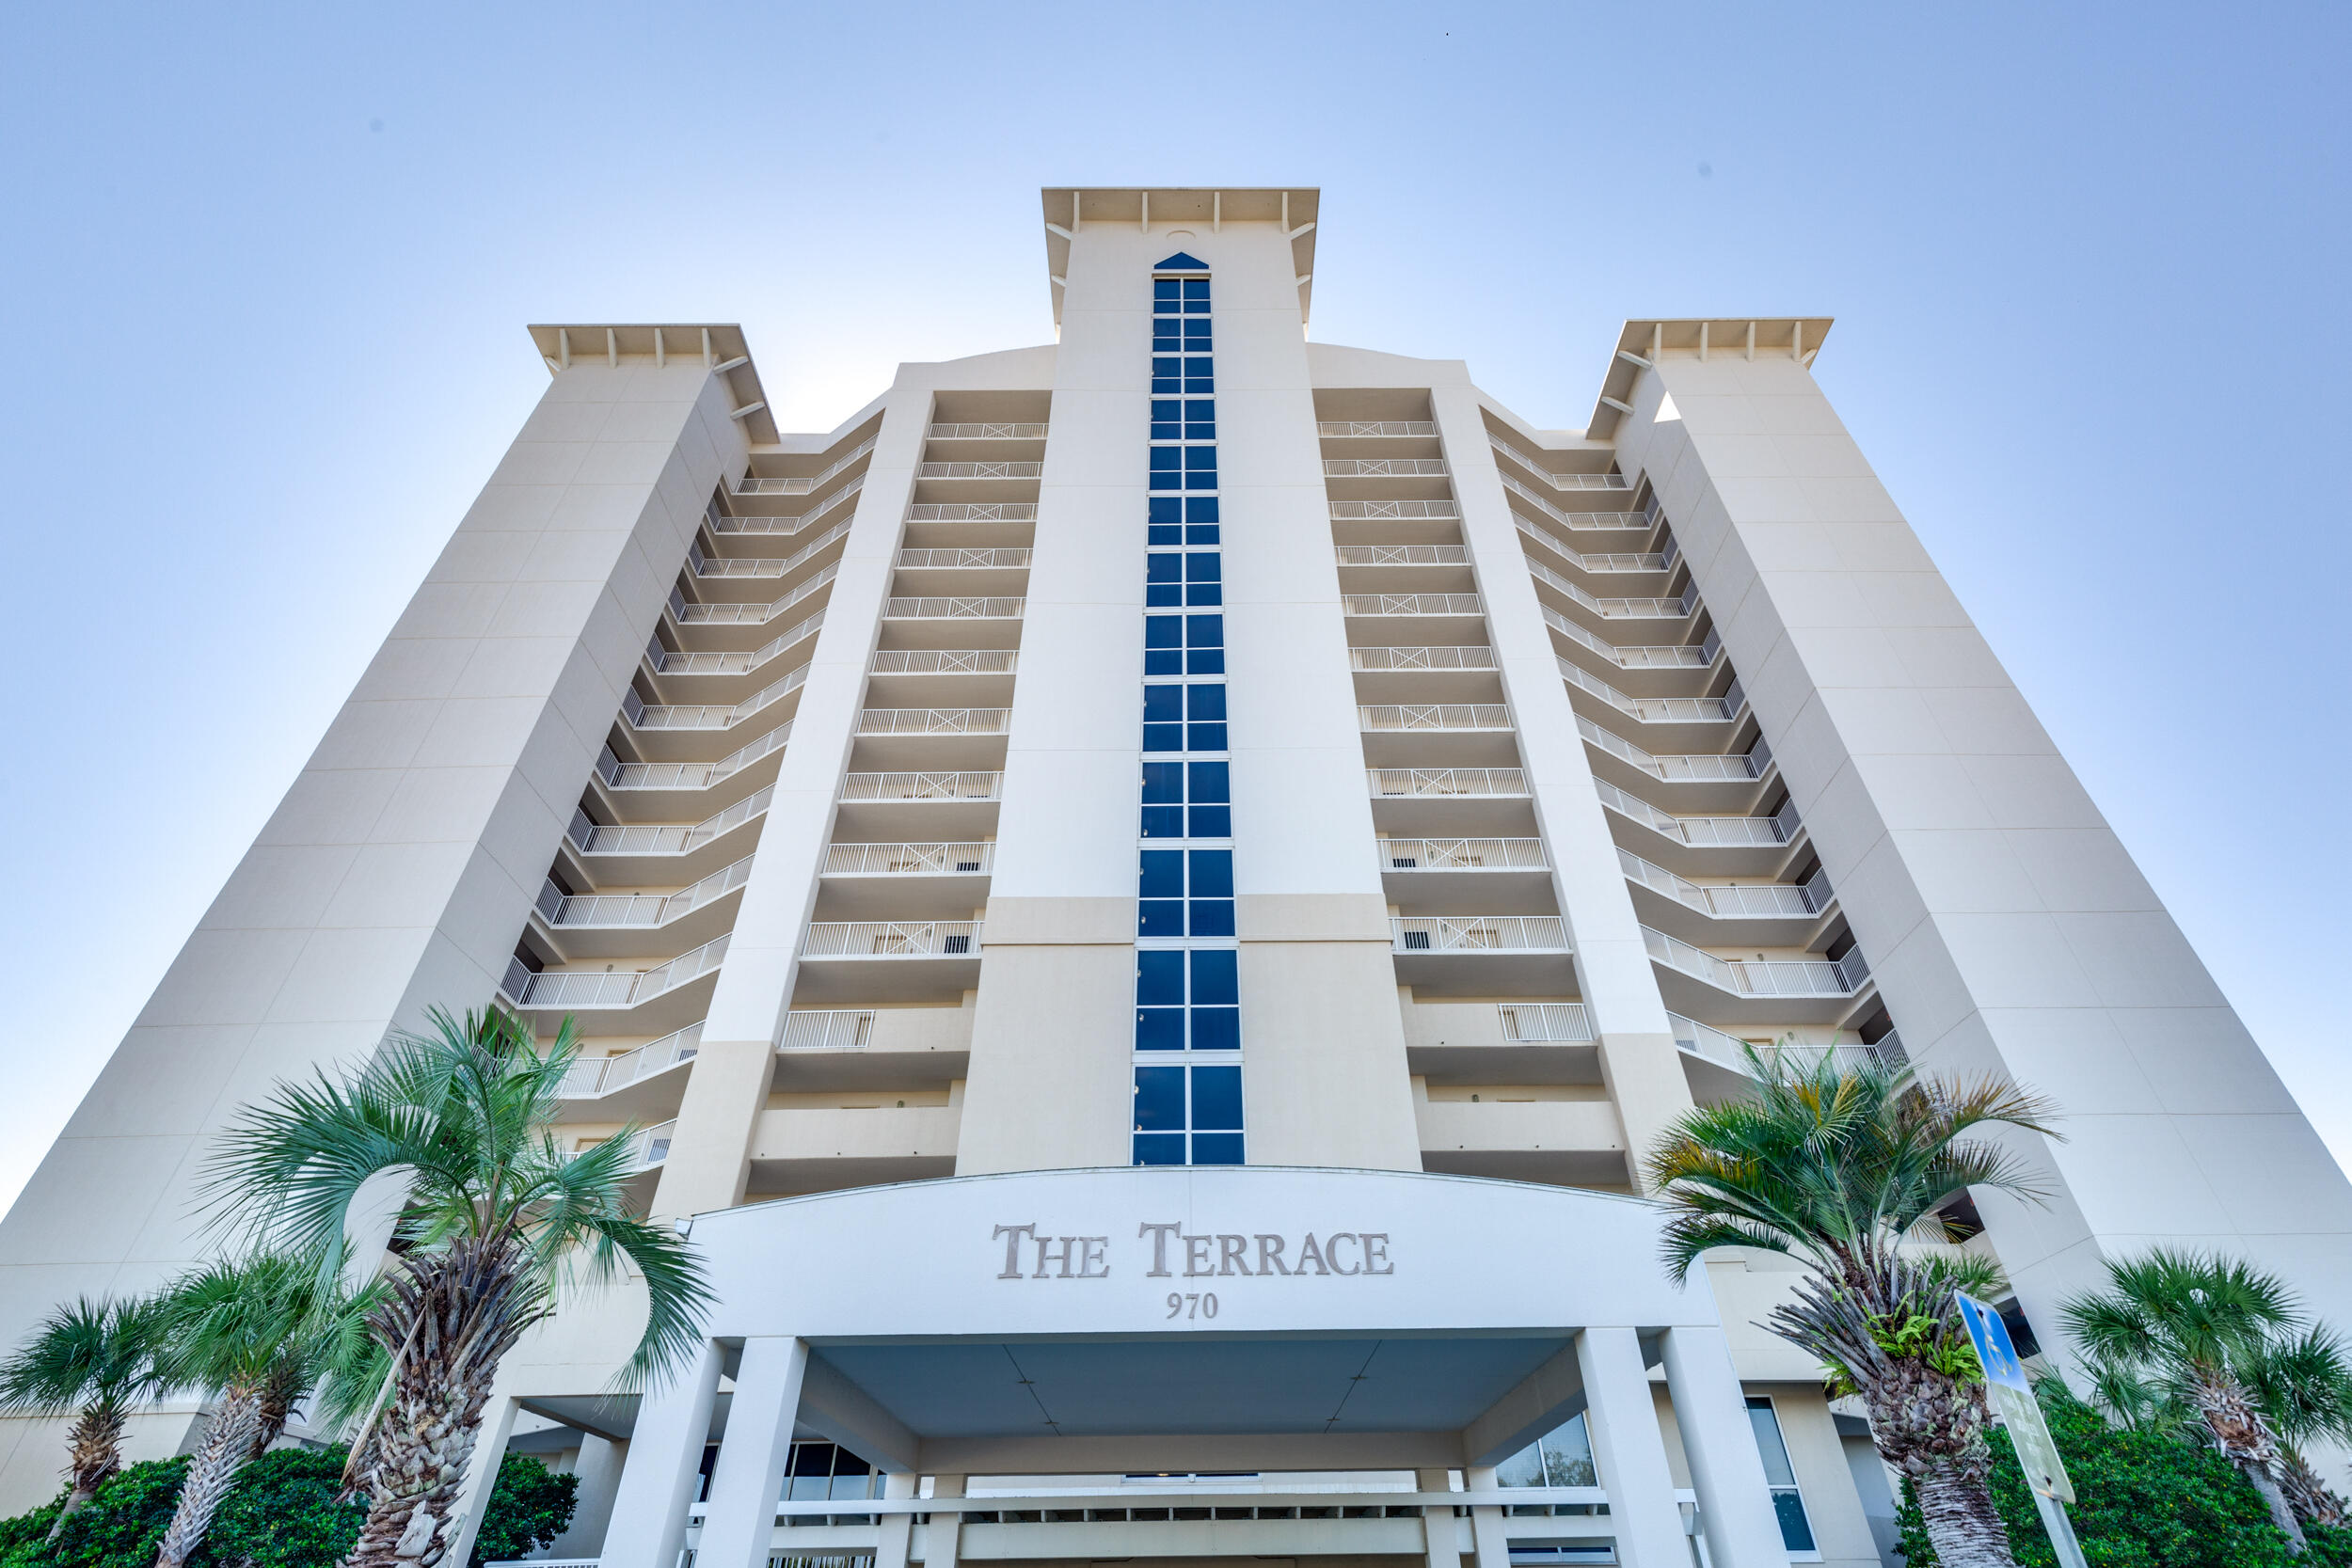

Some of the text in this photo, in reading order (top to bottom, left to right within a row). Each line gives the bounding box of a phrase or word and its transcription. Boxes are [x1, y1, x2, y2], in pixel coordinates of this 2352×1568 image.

[993, 1221, 1394, 1279] THE TERRACE
[1167, 1292, 1218, 1319] 970
